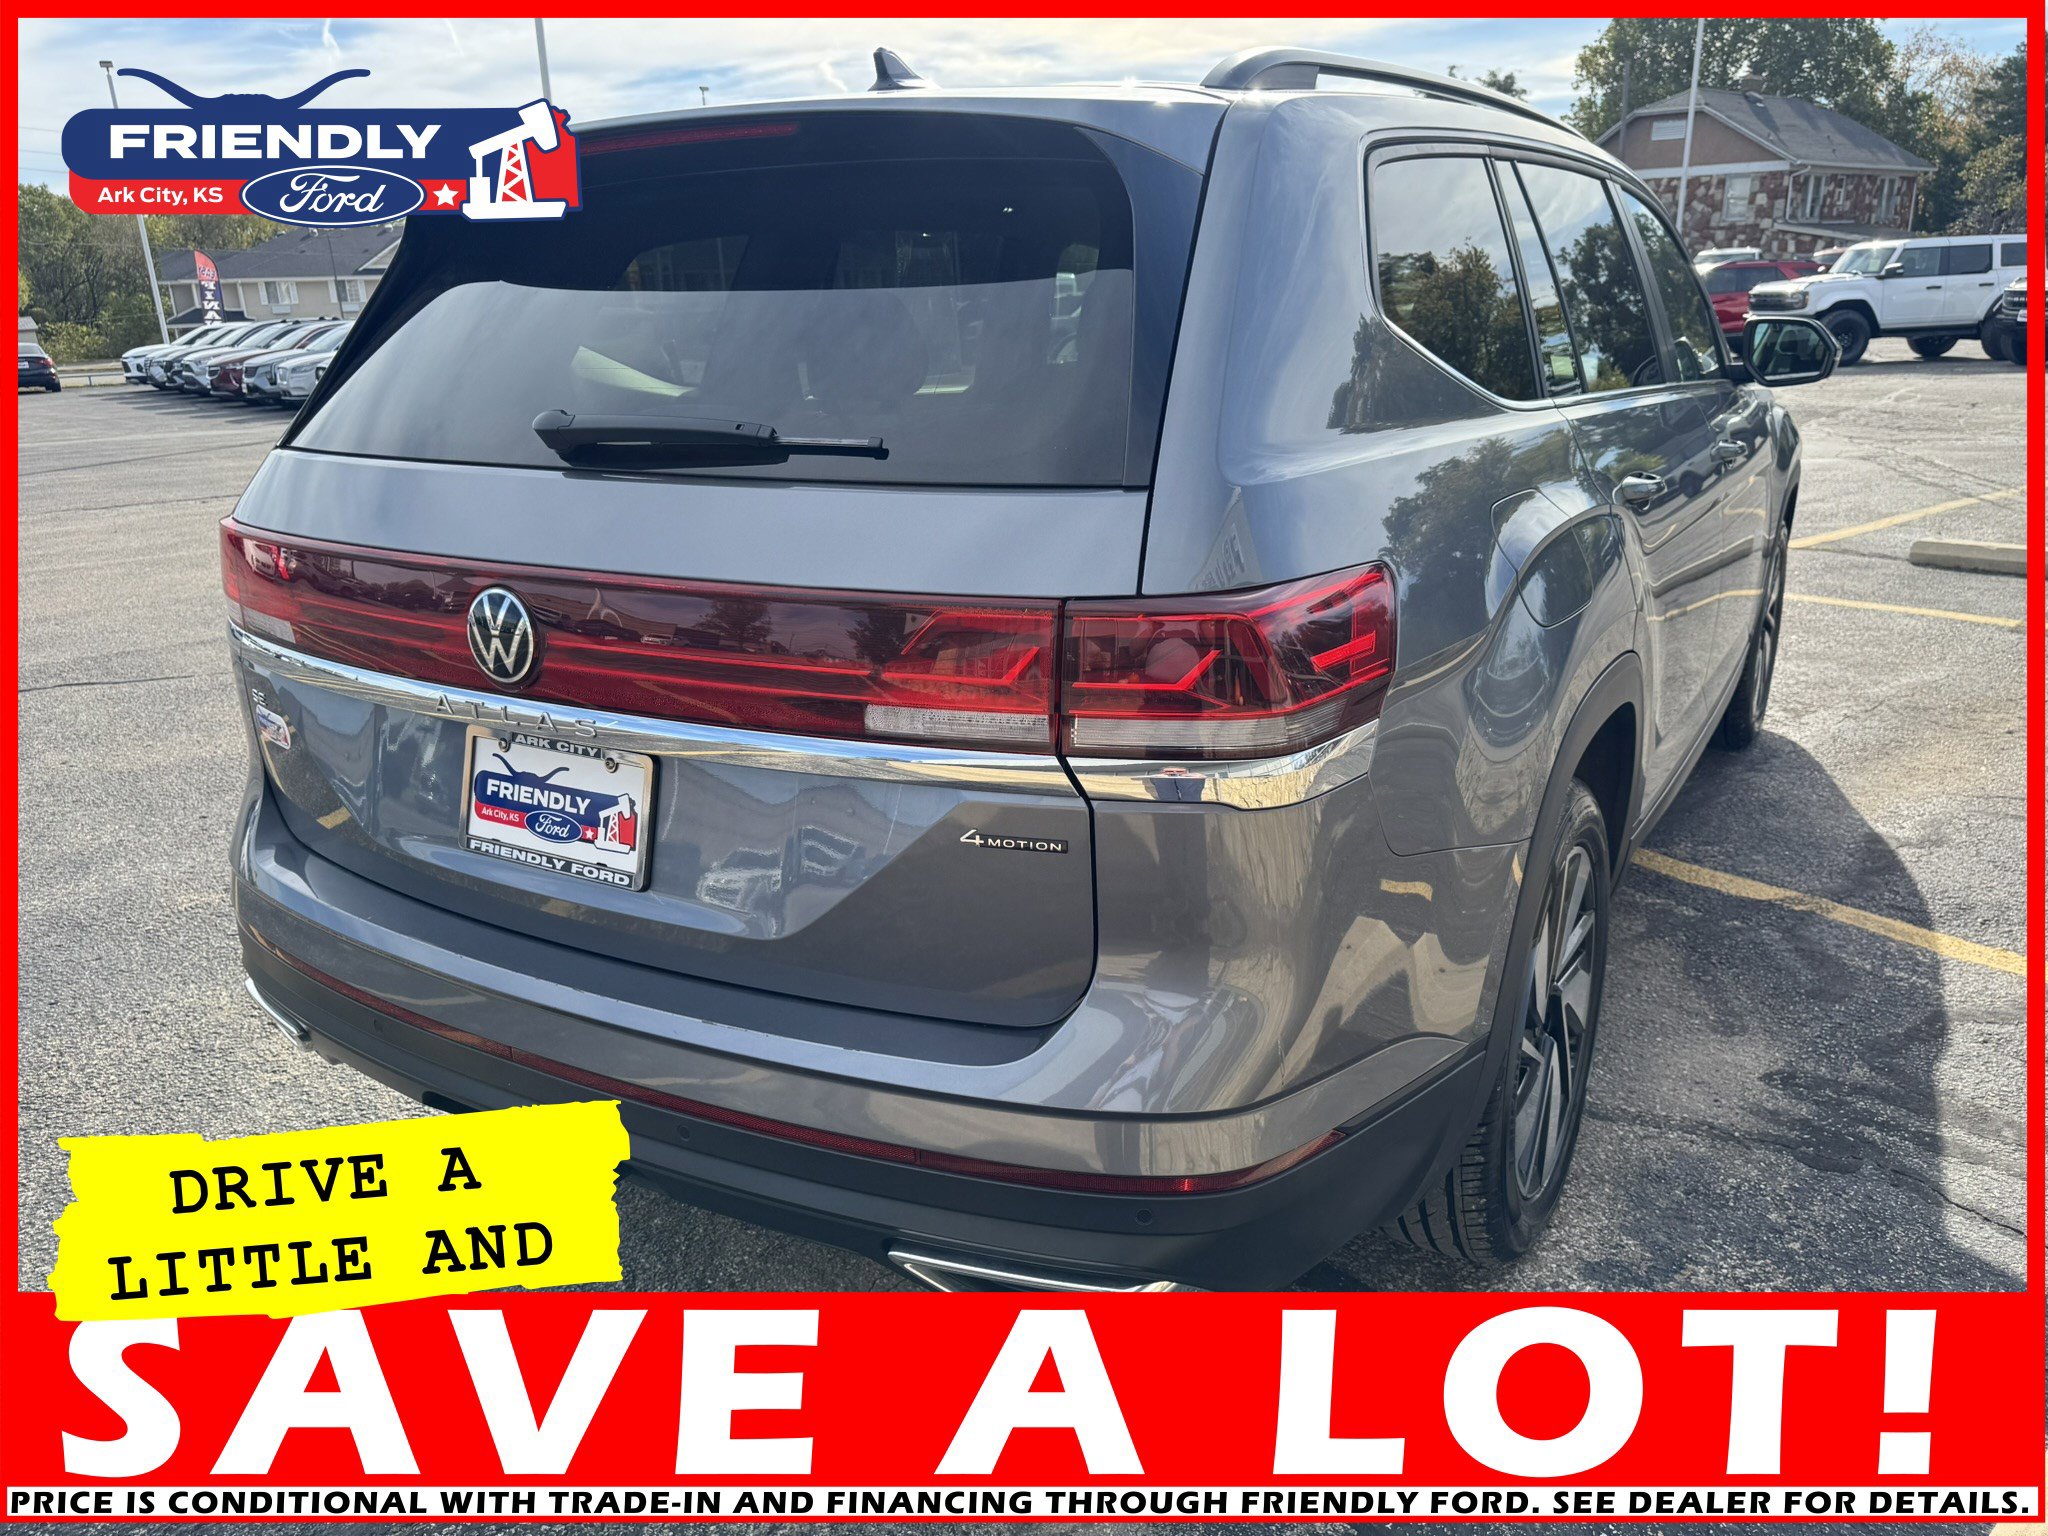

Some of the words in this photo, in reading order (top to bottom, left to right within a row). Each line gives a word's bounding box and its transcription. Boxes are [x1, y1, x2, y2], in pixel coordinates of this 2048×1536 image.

[436, 693, 598, 738] ATLAS
[515, 734, 550, 750] ARK
[556, 741, 599, 757] CITY
[486, 778, 592, 816] FRIENDLY
[481, 806, 493, 817] Ark
[509, 812, 520, 822] KS
[535, 813, 570, 839] Ford
[960, 829, 1062, 851] 4MOTION
[469, 839, 567, 871] FRIENDLY
[570, 863, 630, 887] FORD
